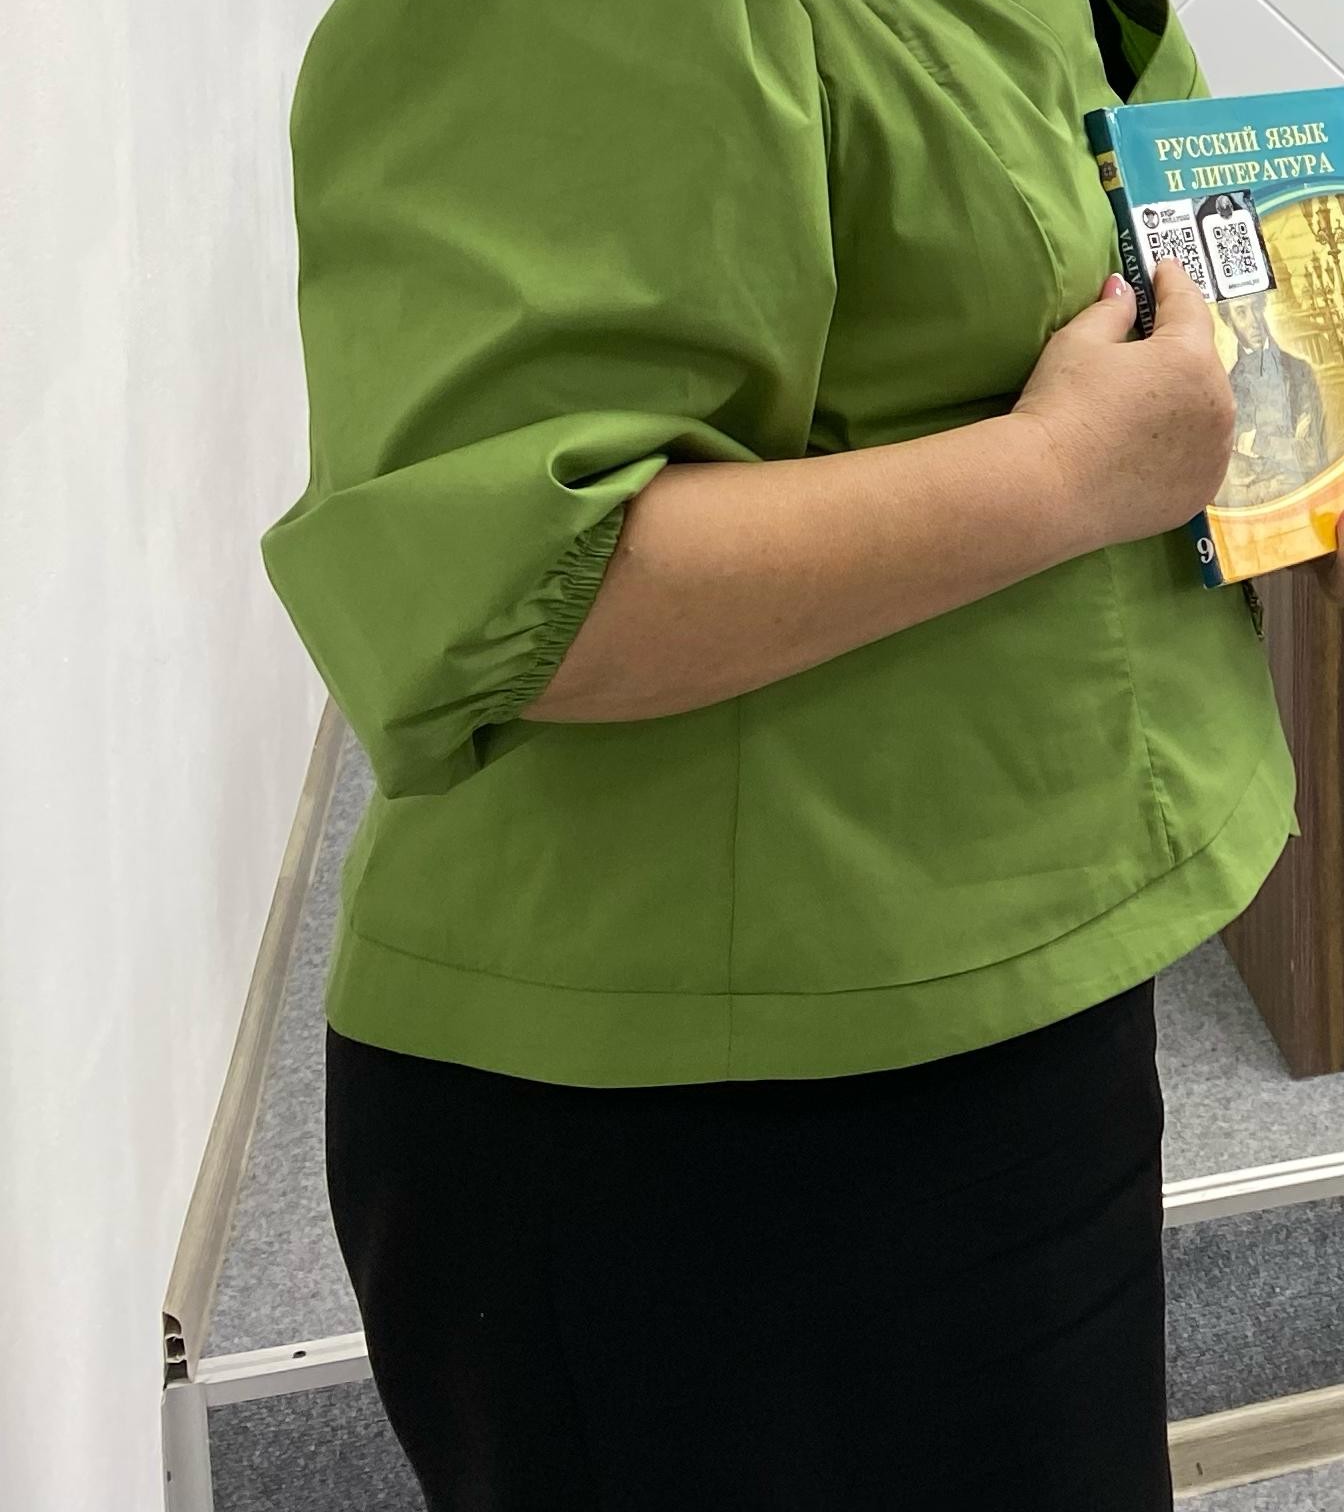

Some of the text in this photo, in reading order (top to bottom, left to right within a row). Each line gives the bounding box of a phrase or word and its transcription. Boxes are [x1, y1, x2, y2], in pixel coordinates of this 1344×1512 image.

[1155, 122, 1329, 161] РУССКИЙ ЯЗЫК
[1164, 152, 1335, 193] И ЛИТЕРАТУРА
[1196, 537, 1214, 564] 9
